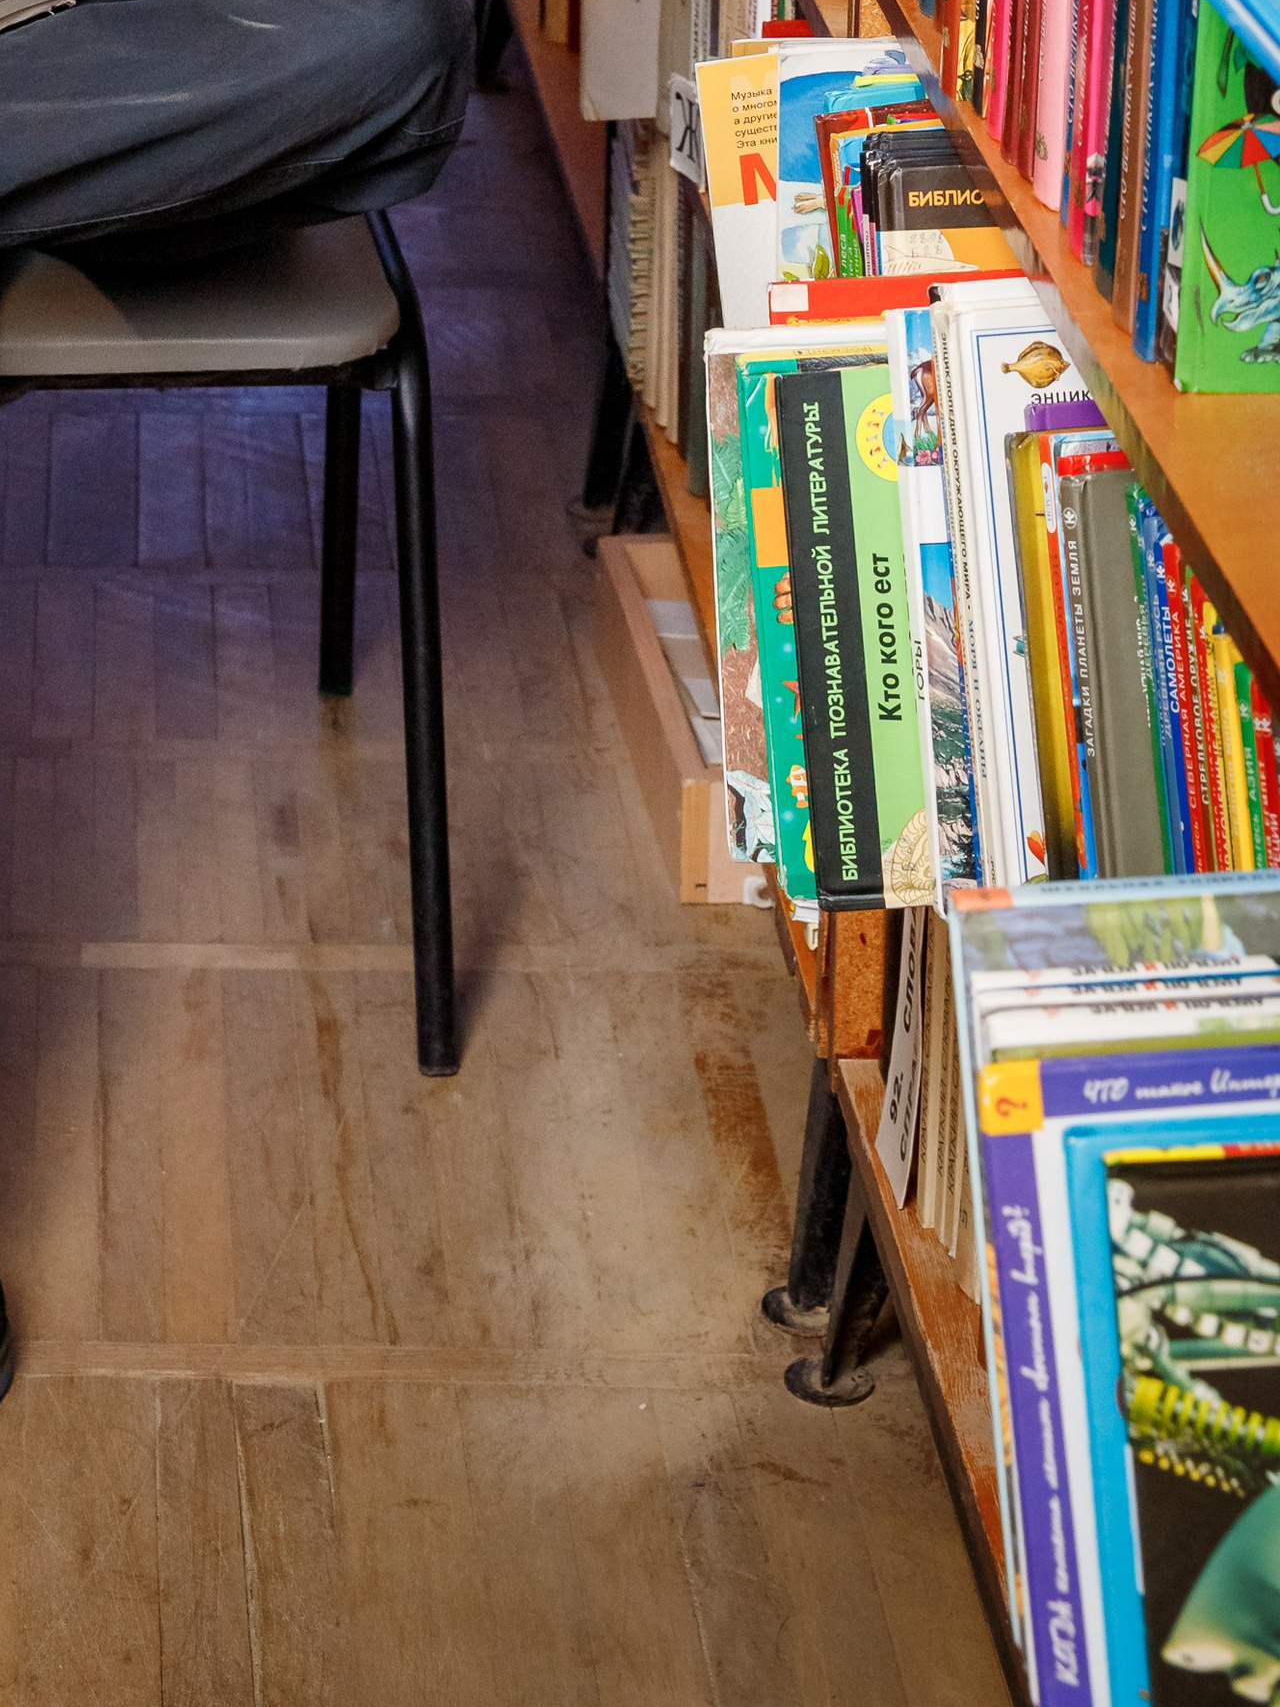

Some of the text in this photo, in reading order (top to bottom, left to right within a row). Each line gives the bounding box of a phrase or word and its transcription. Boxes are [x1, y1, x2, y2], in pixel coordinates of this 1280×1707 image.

[731, 88, 773, 101] Музыка
[732, 105, 739, 113] о
[733, 117, 740, 125] а
[1067, 85, 1075, 123] СТО
[1122, 81, 1133, 173] ВЕЛИКИХ
[1144, 78, 1155, 181] ВЕЛИКИХ
[736, 137, 756, 149] Эта
[940, 332, 958, 447] ЭНЦИКЛОПЕДИЯ
[950, 448, 969, 558] ОКРУЖАЮЩЕГО
[959, 560, 972, 600] МИРА
[805, 401, 860, 881] БИБЛИОТЕКА ПОЗНАВАТЕЛЬНОЙ ЛИТЕРАТУРЫ
[871, 553, 902, 722] Кто кого ест
[912, 639, 925, 702] ГОРЫ
[1067, 539, 1096, 757] ЗАГАДКИ ПЛАНЕТЫ ЗЕМЛЯ
[1161, 606, 1181, 714] САМОЛЕТЫ
[1171, 611, 1198, 809] СЕВЕРНАЯ АМЕРИКА
[1192, 694, 1210, 805] СТРЕЛКОВОЕ
[1243, 746, 1258, 802] АЗИЯ
[889, 1072, 904, 1125] 92.
